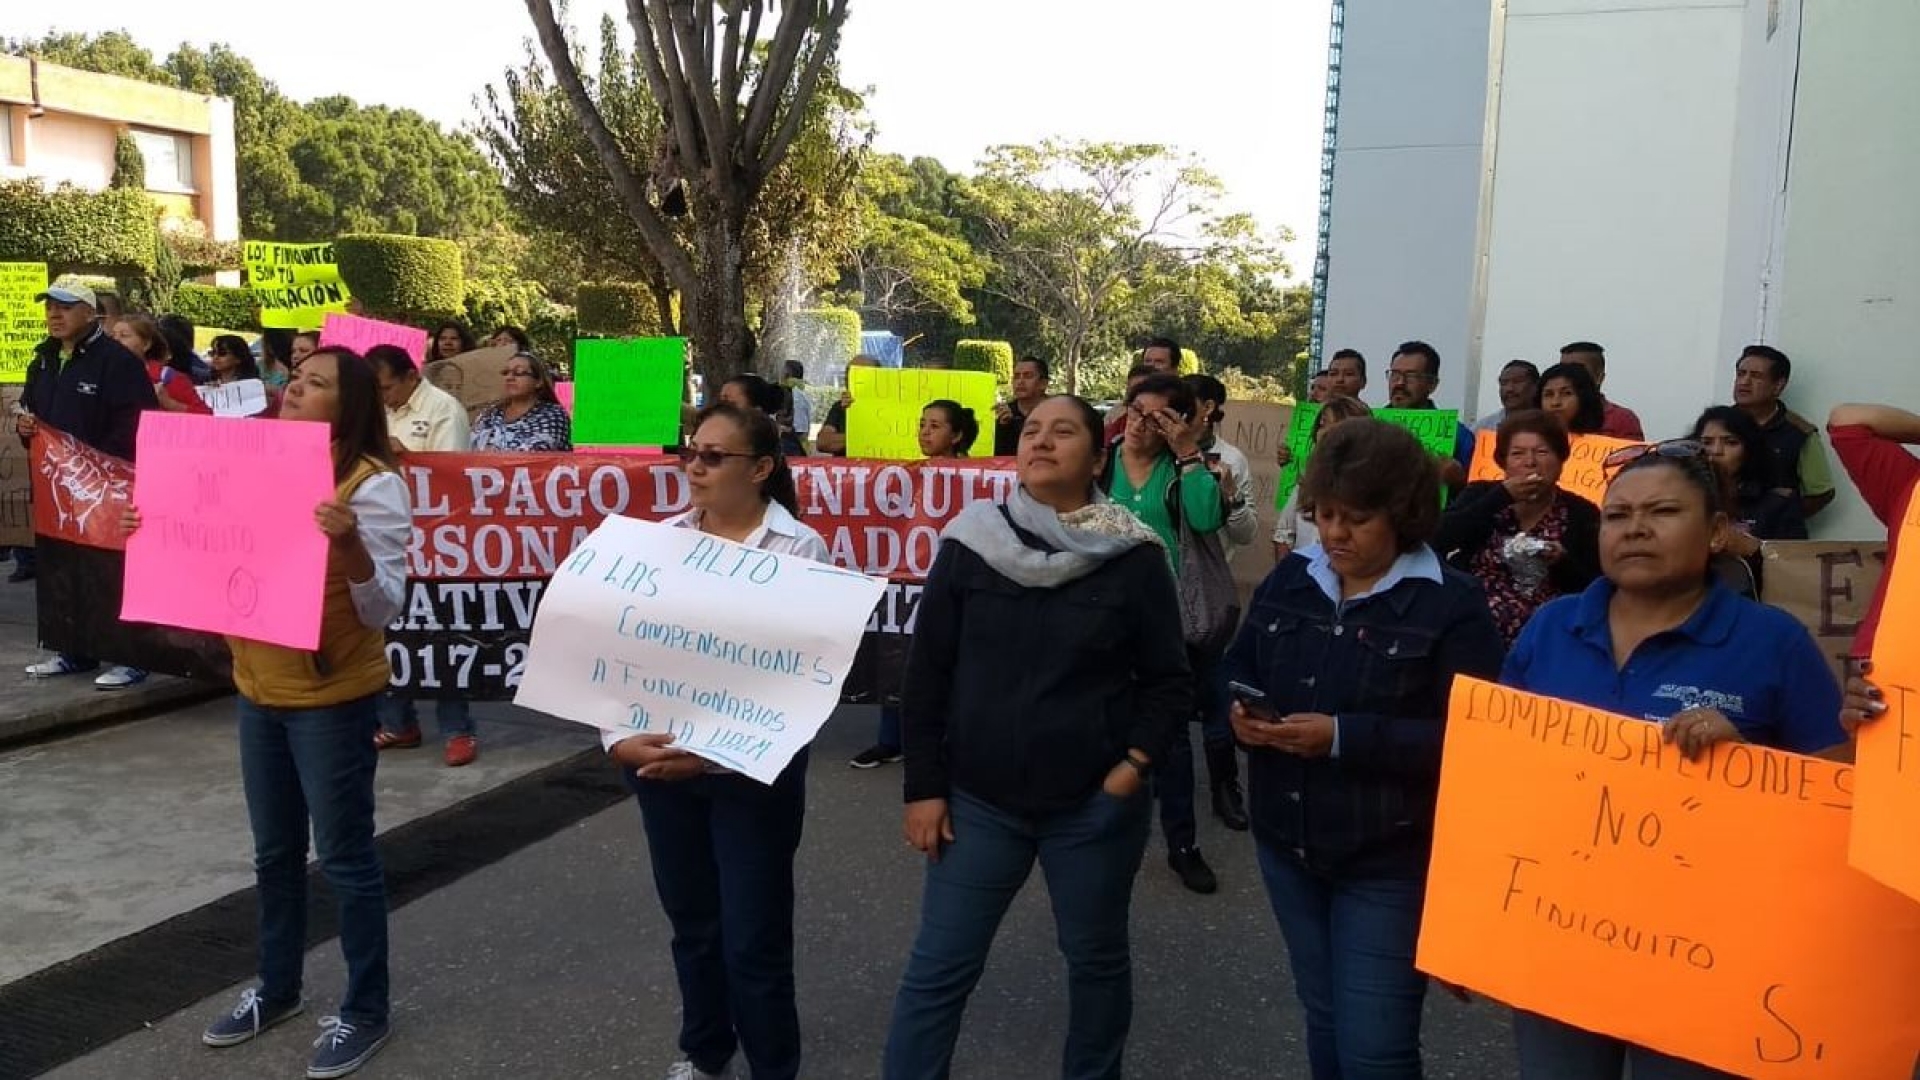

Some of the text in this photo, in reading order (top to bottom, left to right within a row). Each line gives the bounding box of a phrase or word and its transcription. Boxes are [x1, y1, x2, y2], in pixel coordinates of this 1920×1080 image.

[401, 466, 449, 516] L
[464, 465, 630, 518] PAGO
[567, 549, 661, 598] A LAS
[682, 536, 779, 585] ALTO
[591, 658, 606, 682] A
[1503, 854, 1714, 970] FINIQUITO
